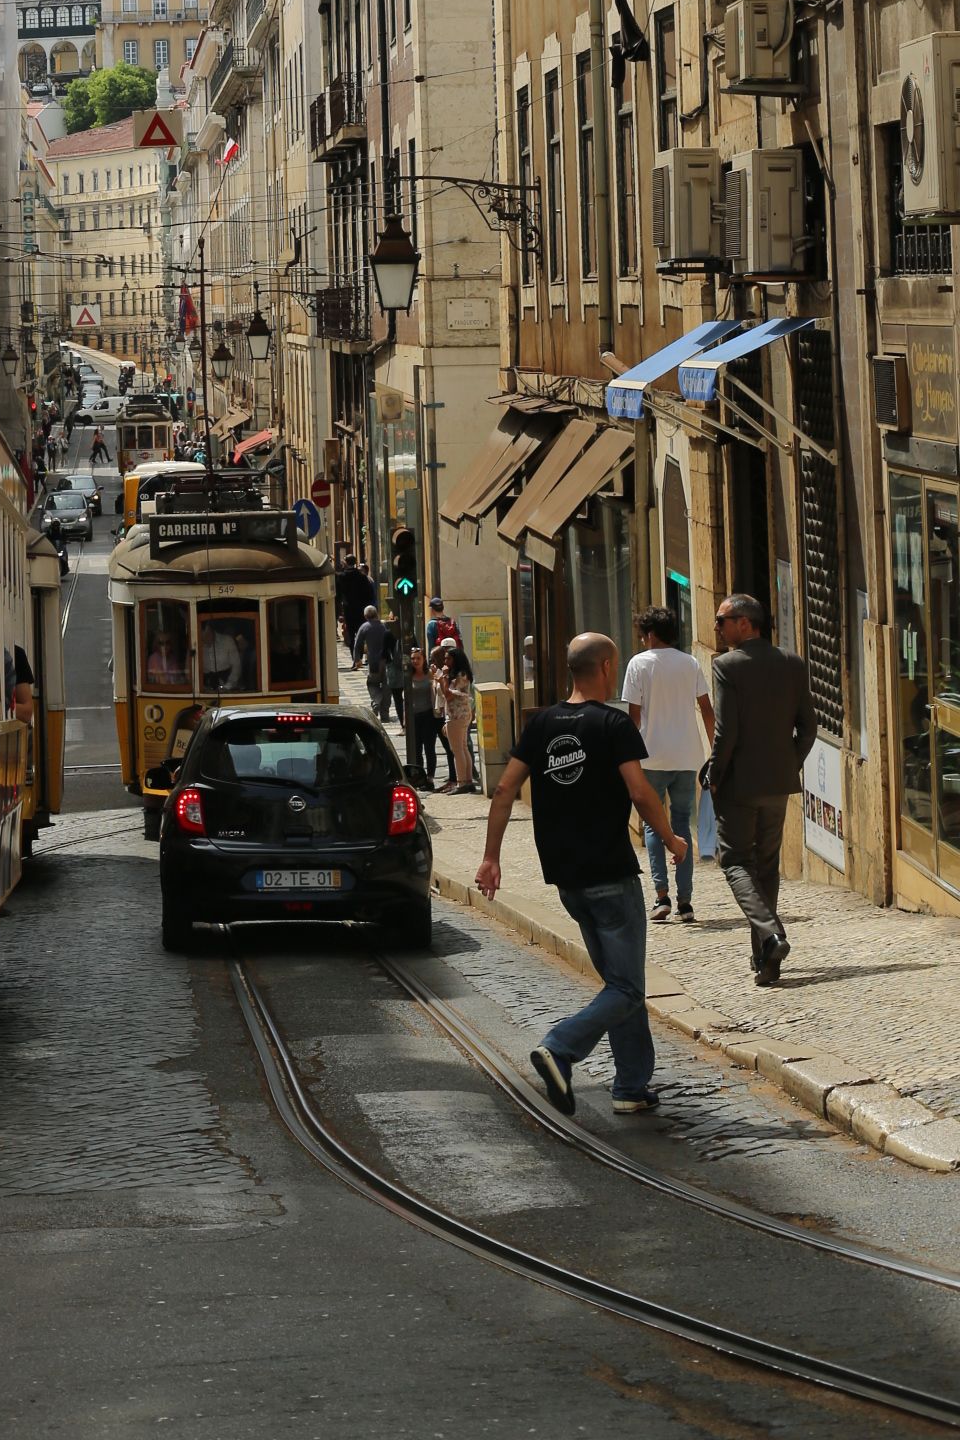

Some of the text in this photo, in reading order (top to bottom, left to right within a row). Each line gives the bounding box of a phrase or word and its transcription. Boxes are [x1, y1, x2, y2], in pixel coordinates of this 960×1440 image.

[158, 522, 217, 537] CARREIRA
[218, 585, 235, 594] 549
[547, 748, 586, 768] Romana
